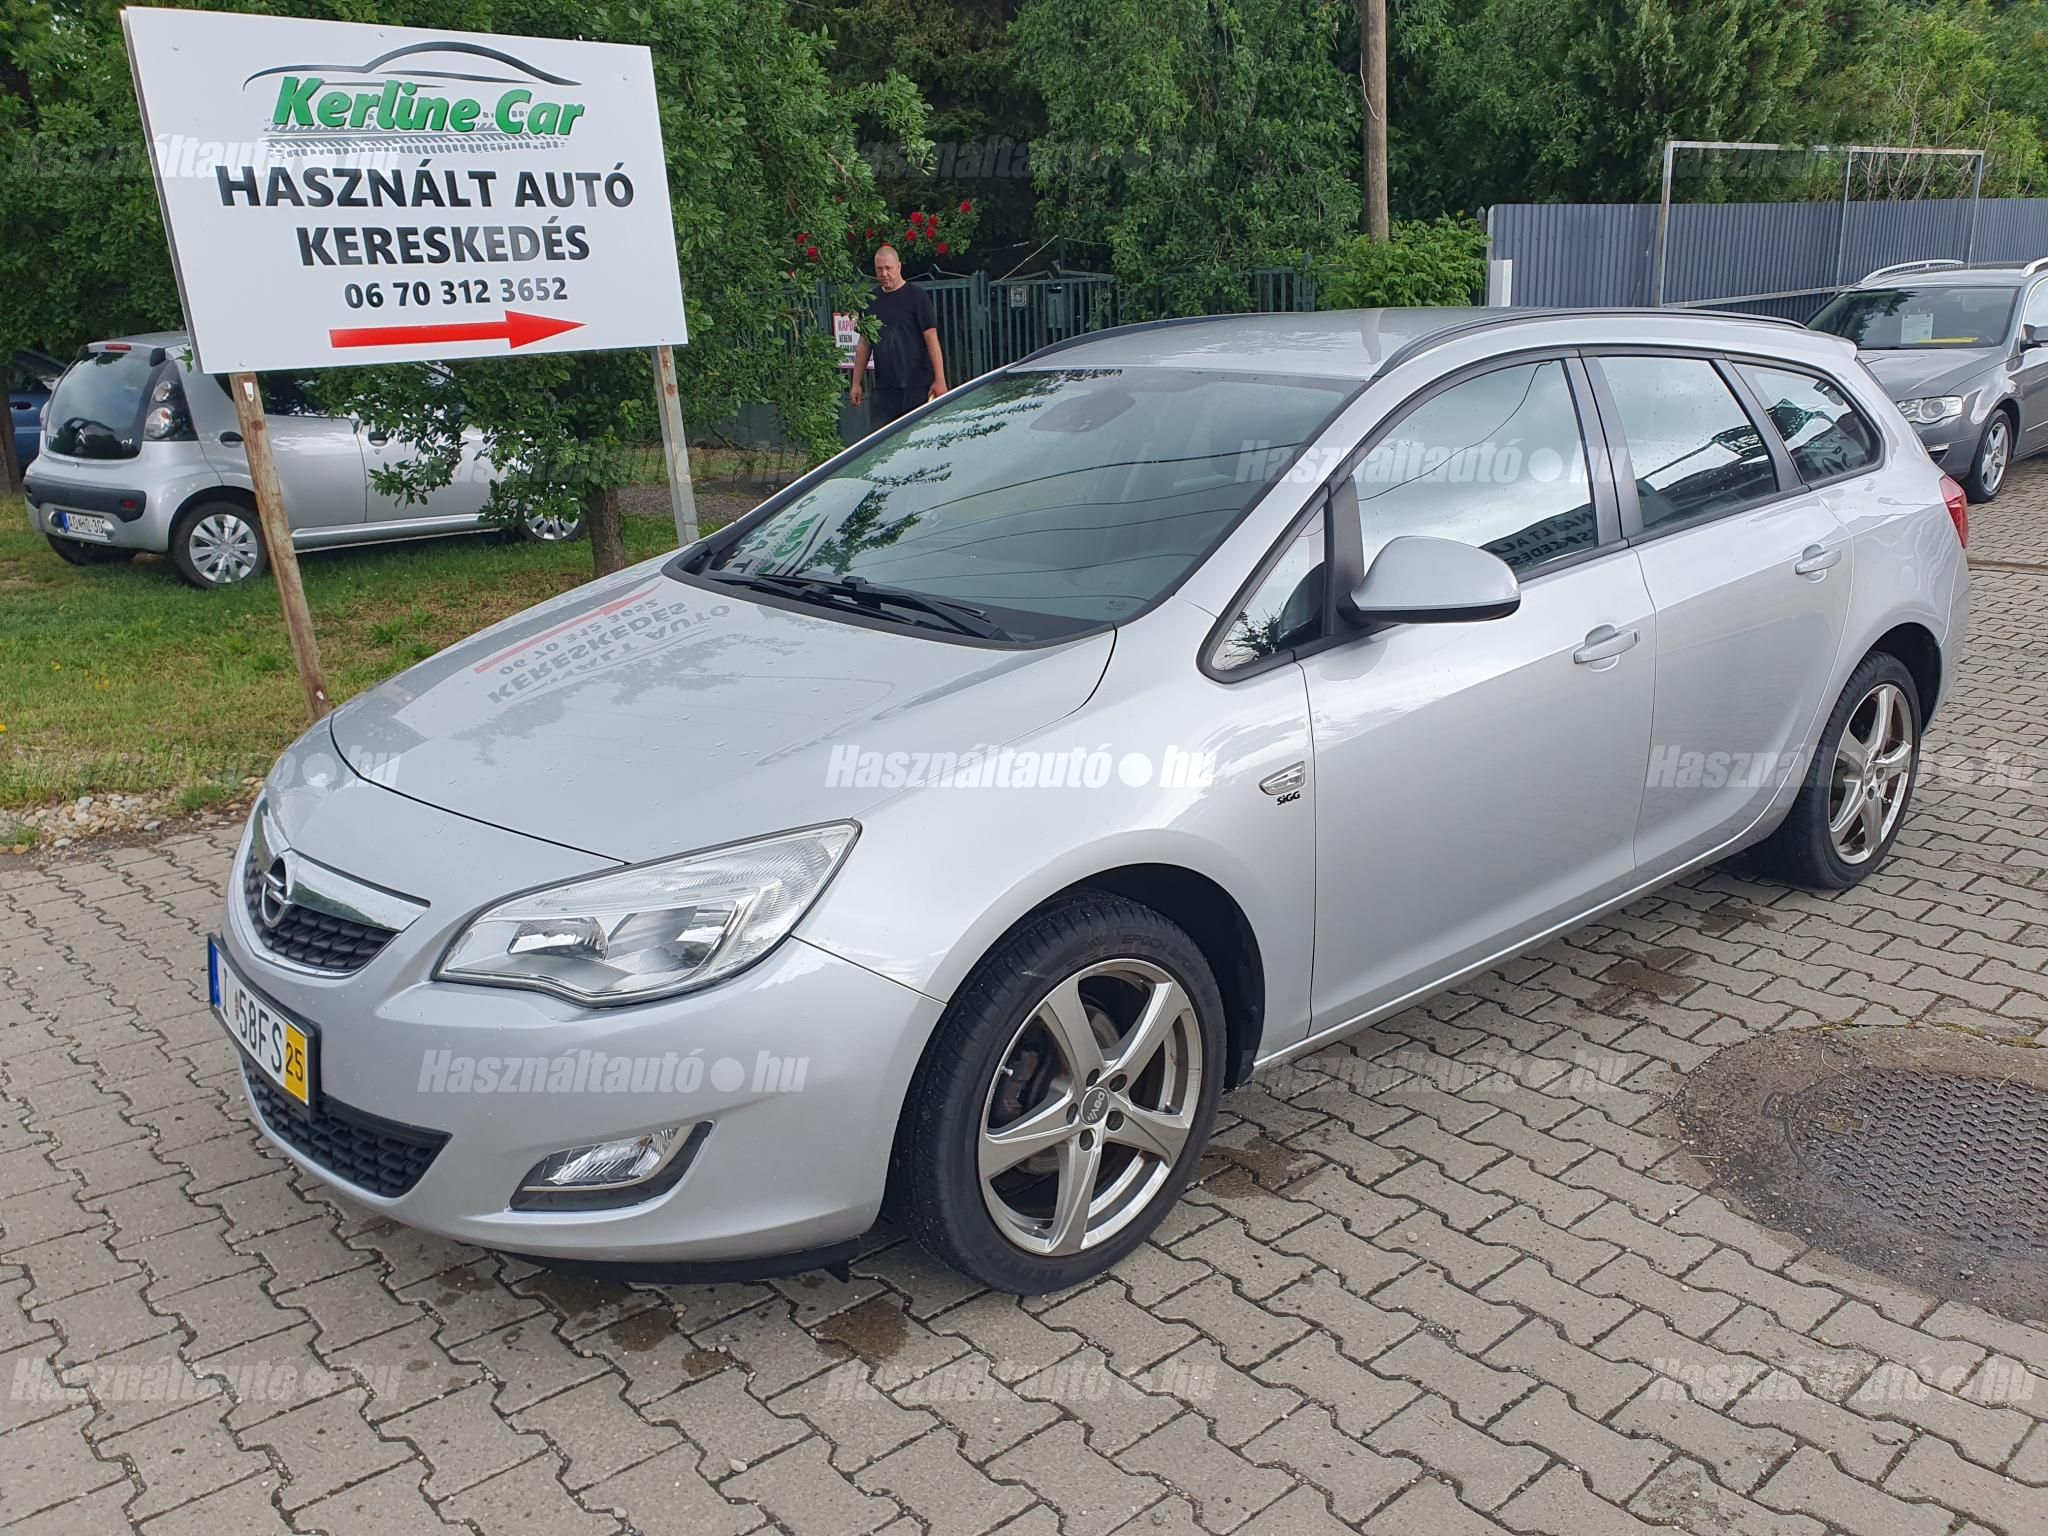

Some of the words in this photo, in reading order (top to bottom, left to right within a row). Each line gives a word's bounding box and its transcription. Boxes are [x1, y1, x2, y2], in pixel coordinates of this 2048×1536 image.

[272, 76, 480, 131] Kerline
[495, 88, 584, 136] Car
[215, 159, 497, 207] HASZNÁLT
[514, 162, 634, 207] AUTÓ
[296, 216, 590, 266] KERESKEDÉS
[344, 282, 384, 308] 06
[392, 282, 430, 307] 70
[442, 279, 490, 305] 312
[501, 277, 568, 302] 3652
[285, 1041, 304, 1083] 25
